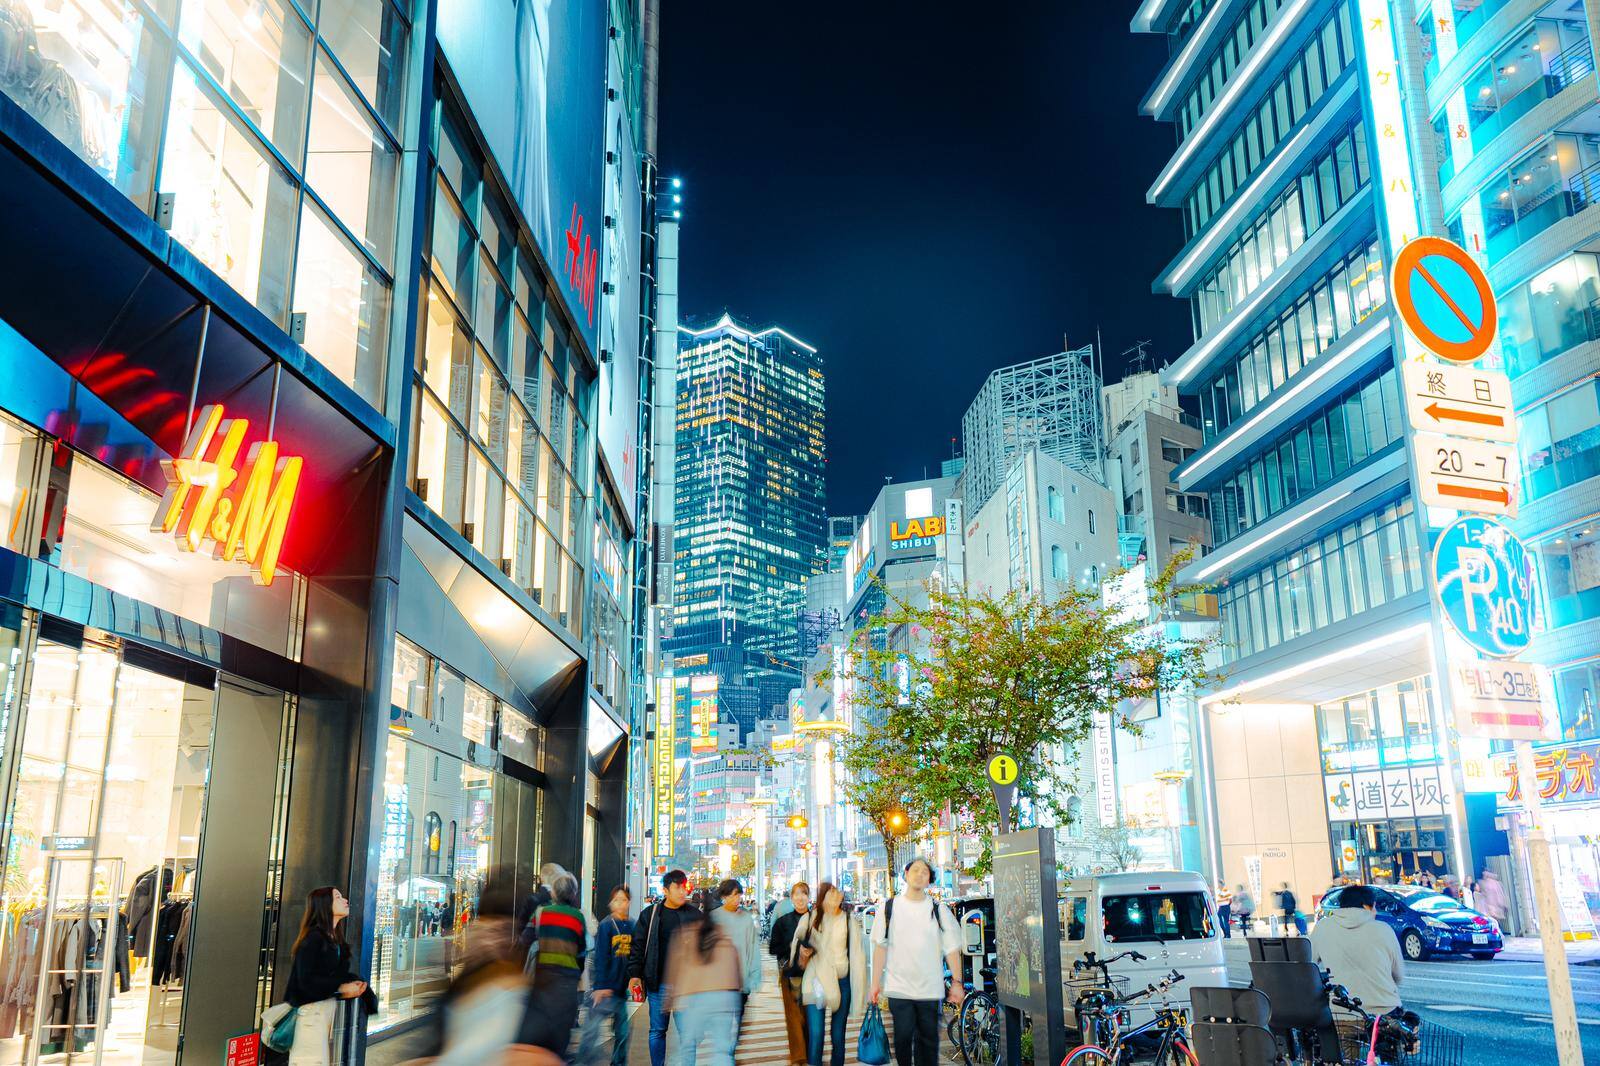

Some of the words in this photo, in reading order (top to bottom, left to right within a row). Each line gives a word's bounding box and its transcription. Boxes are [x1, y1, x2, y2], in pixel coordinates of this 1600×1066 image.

[564, 202, 598, 329] H&M
[1426, 371, 1492, 402] 終日
[151, 404, 303, 586] H&M
[1456, 546, 1498, 633] P
[1495, 599, 1523, 636] 40
